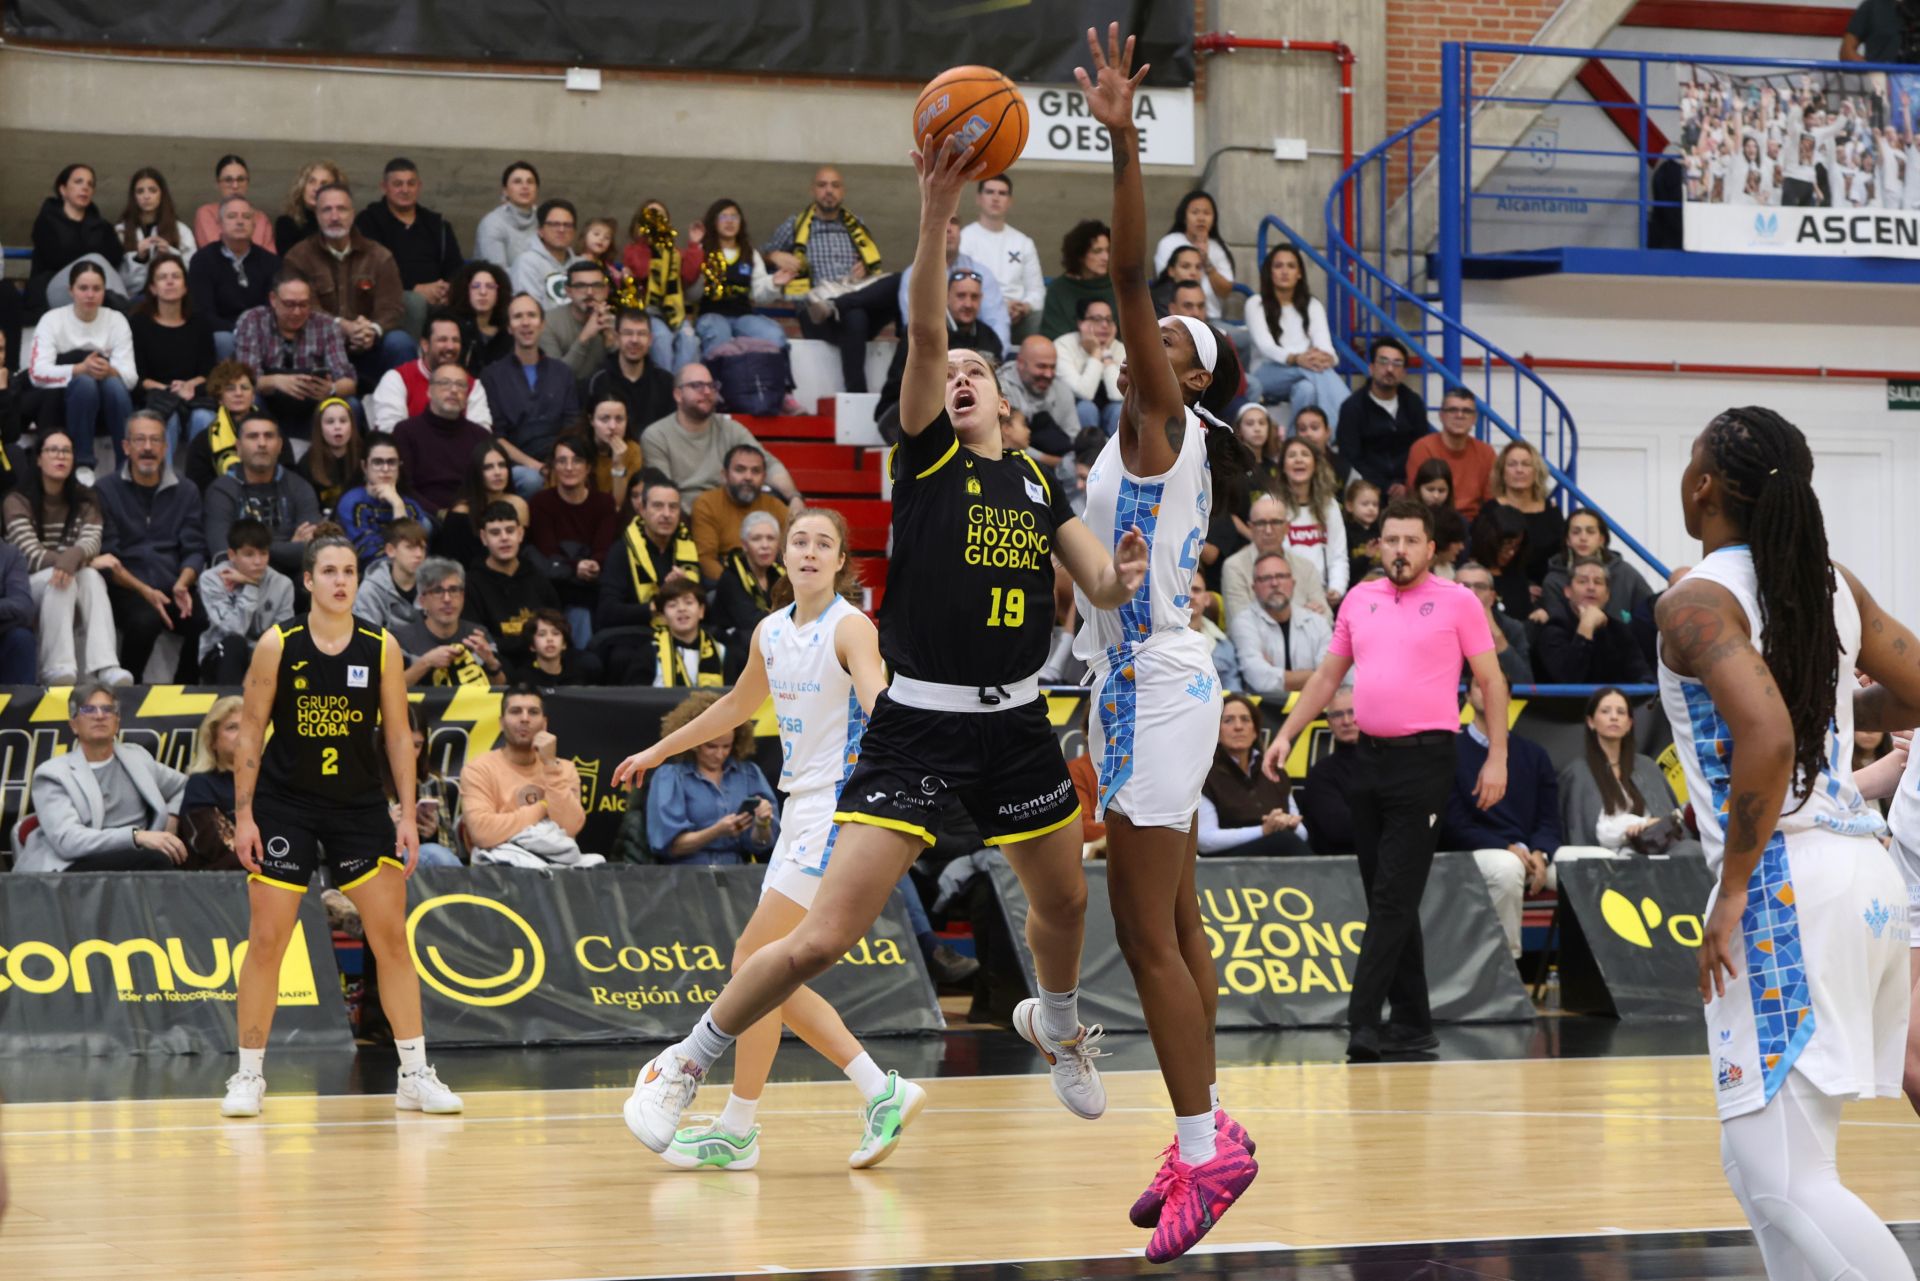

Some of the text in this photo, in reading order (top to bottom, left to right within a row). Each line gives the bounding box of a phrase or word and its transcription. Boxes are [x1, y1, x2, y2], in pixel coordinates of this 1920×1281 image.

[1038, 90, 1157, 121] GRA
[1048, 124, 1148, 153] OESE
[1796, 215, 1919, 247] ASCEN
[969, 504, 1035, 530] GRUPO
[964, 544, 1040, 571] GLOBAL
[986, 587, 1025, 628] 19
[297, 695, 349, 710] GRUPO
[297, 709, 364, 724] HOZONO
[777, 715, 803, 735] rsa
[321, 746, 339, 776] 2
[599, 794, 627, 812] Alc
[998, 778, 1072, 816] Alcantarilla
[1197, 887, 1315, 924] UPO
[575, 935, 726, 973] Costa
[1218, 957, 1354, 996] OBAL
[164, 988, 238, 1003] fotocopiador
[590, 984, 718, 1012] Región de
